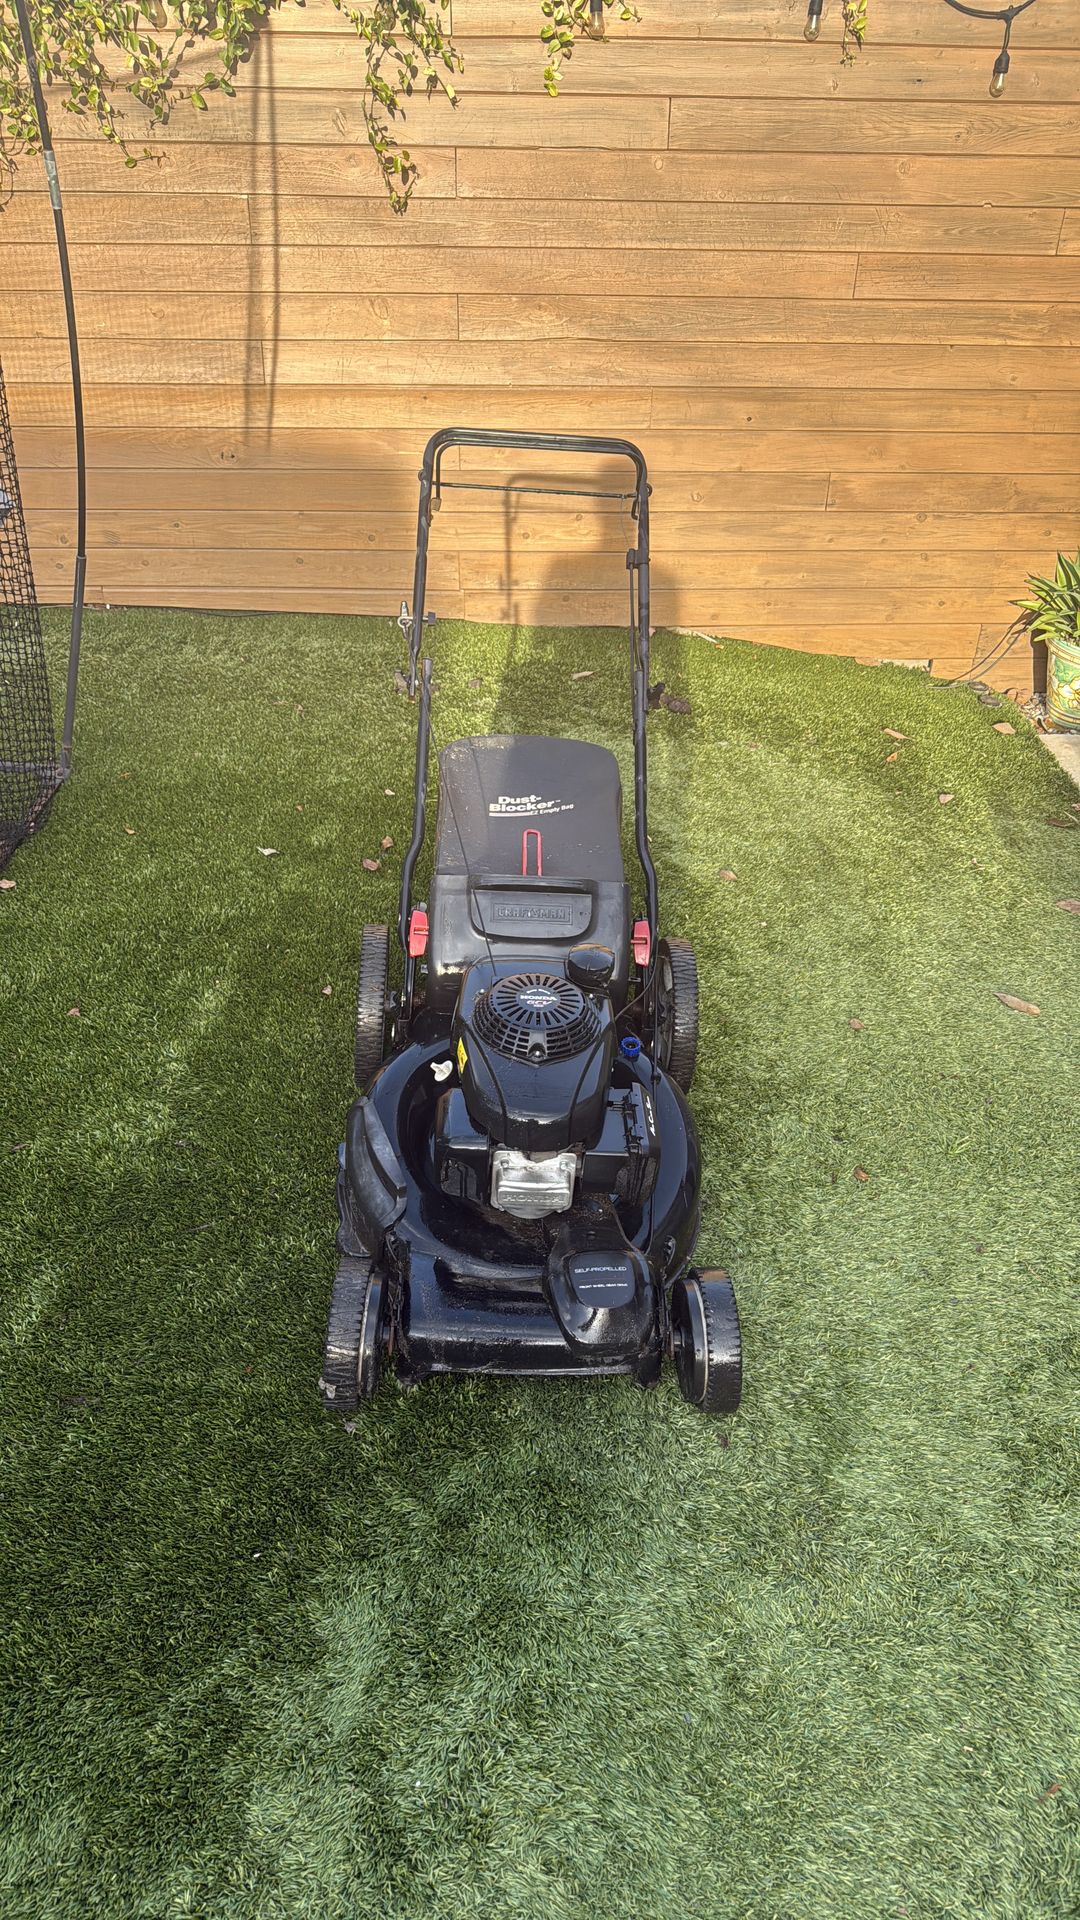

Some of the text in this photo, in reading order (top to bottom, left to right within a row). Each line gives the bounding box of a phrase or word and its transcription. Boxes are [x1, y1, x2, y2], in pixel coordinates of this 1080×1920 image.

[498, 795, 542, 804] Dust-
[489, 801, 555, 812] Blocker
[540, 806, 560, 815] Empty
[497, 907, 566, 920] CRAFTSMAN
[502, 1193, 564, 1203] HONDA
[574, 1266, 627, 1274] SELF-PROPELLED
